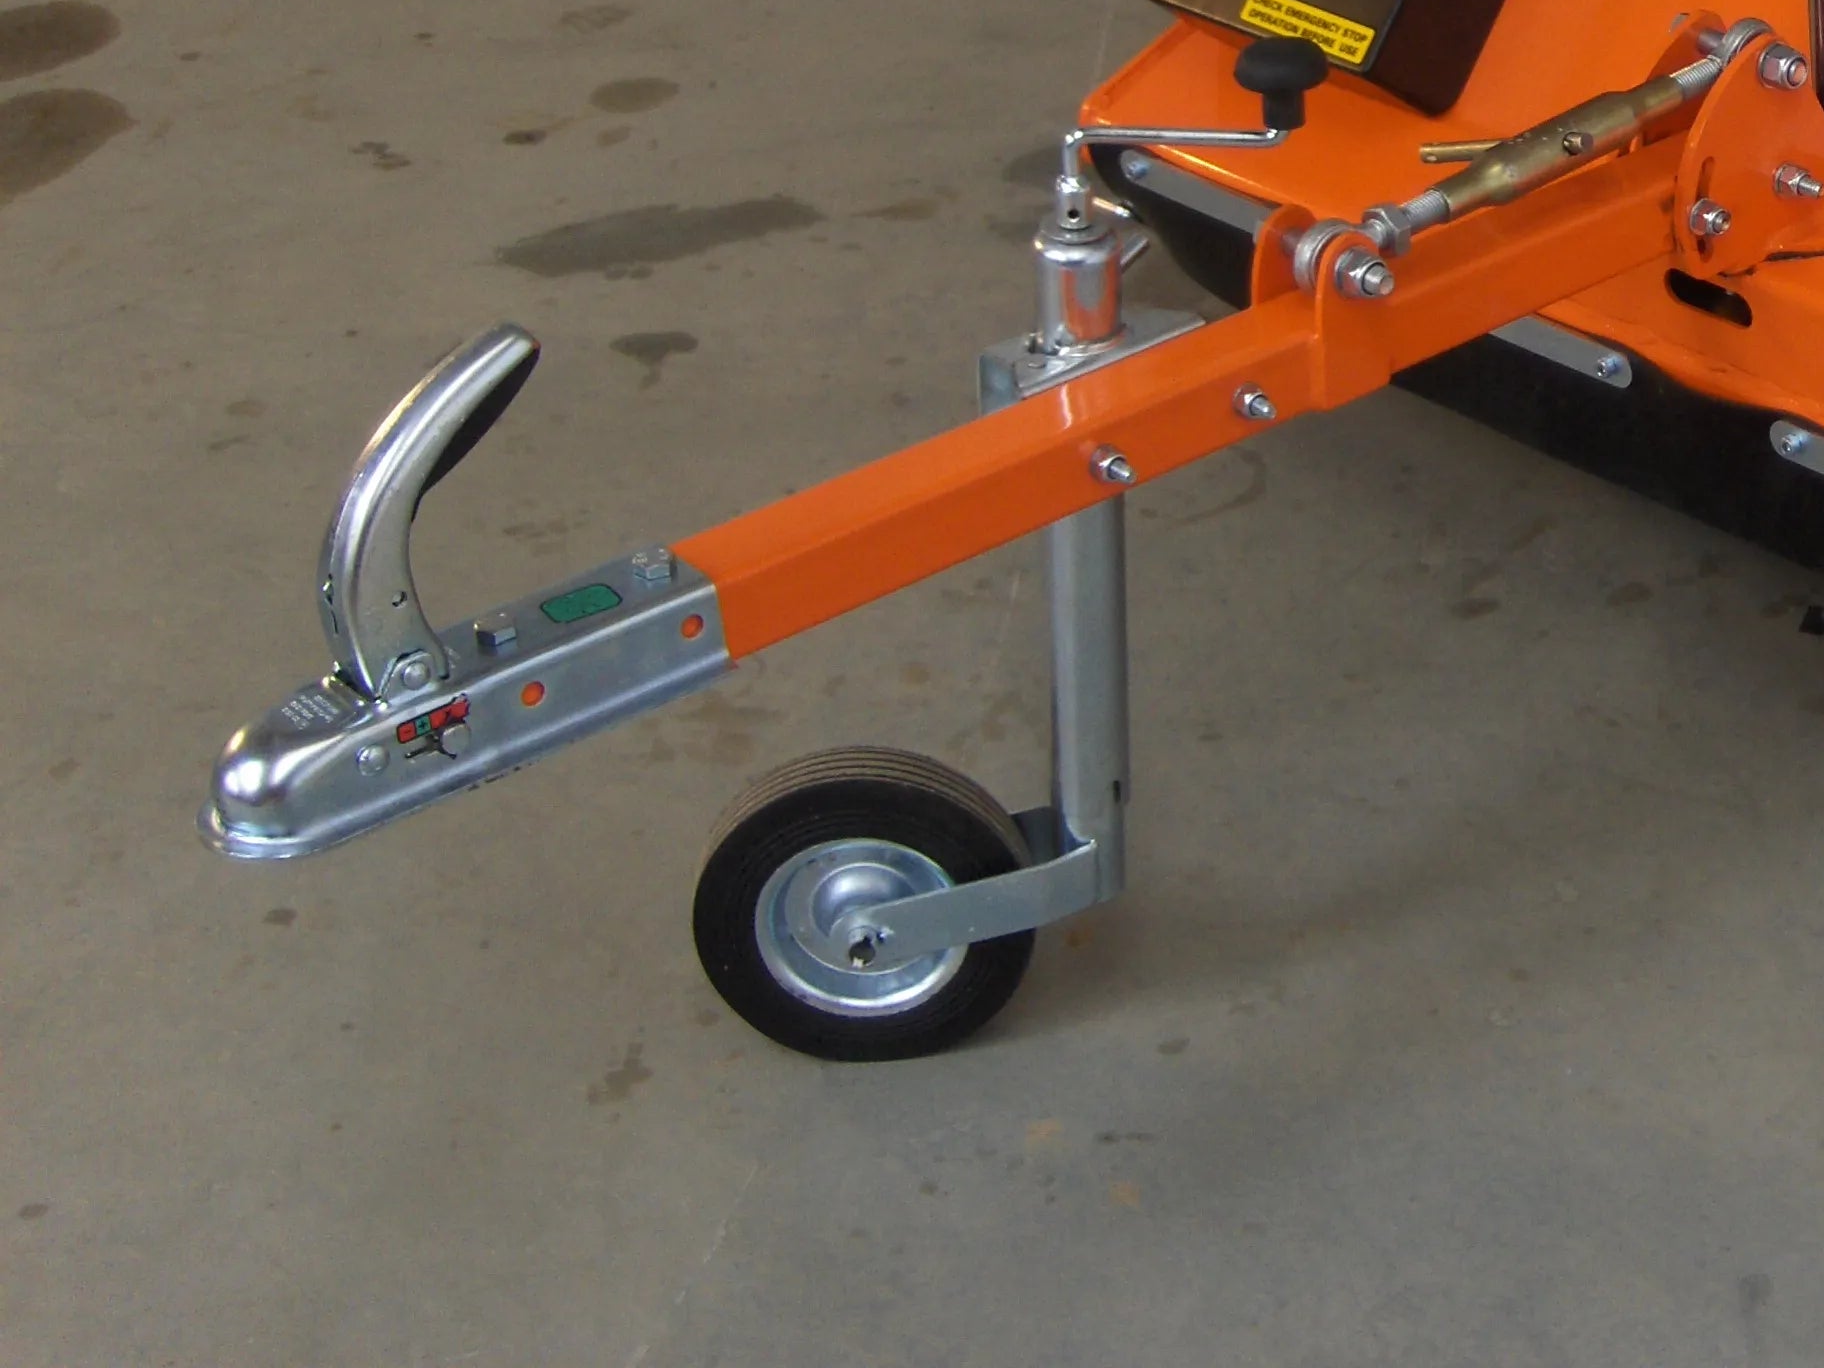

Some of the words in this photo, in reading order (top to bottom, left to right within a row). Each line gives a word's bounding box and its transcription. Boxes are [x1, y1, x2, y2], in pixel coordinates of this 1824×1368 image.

[1249, 8, 1299, 34] OPERATION
[1300, 28, 1336, 48] BEFORE
[1338, 41, 1359, 56] USE
[1284, 6, 1341, 33] EMERGENCY
[1342, 28, 1368, 43] STOP
